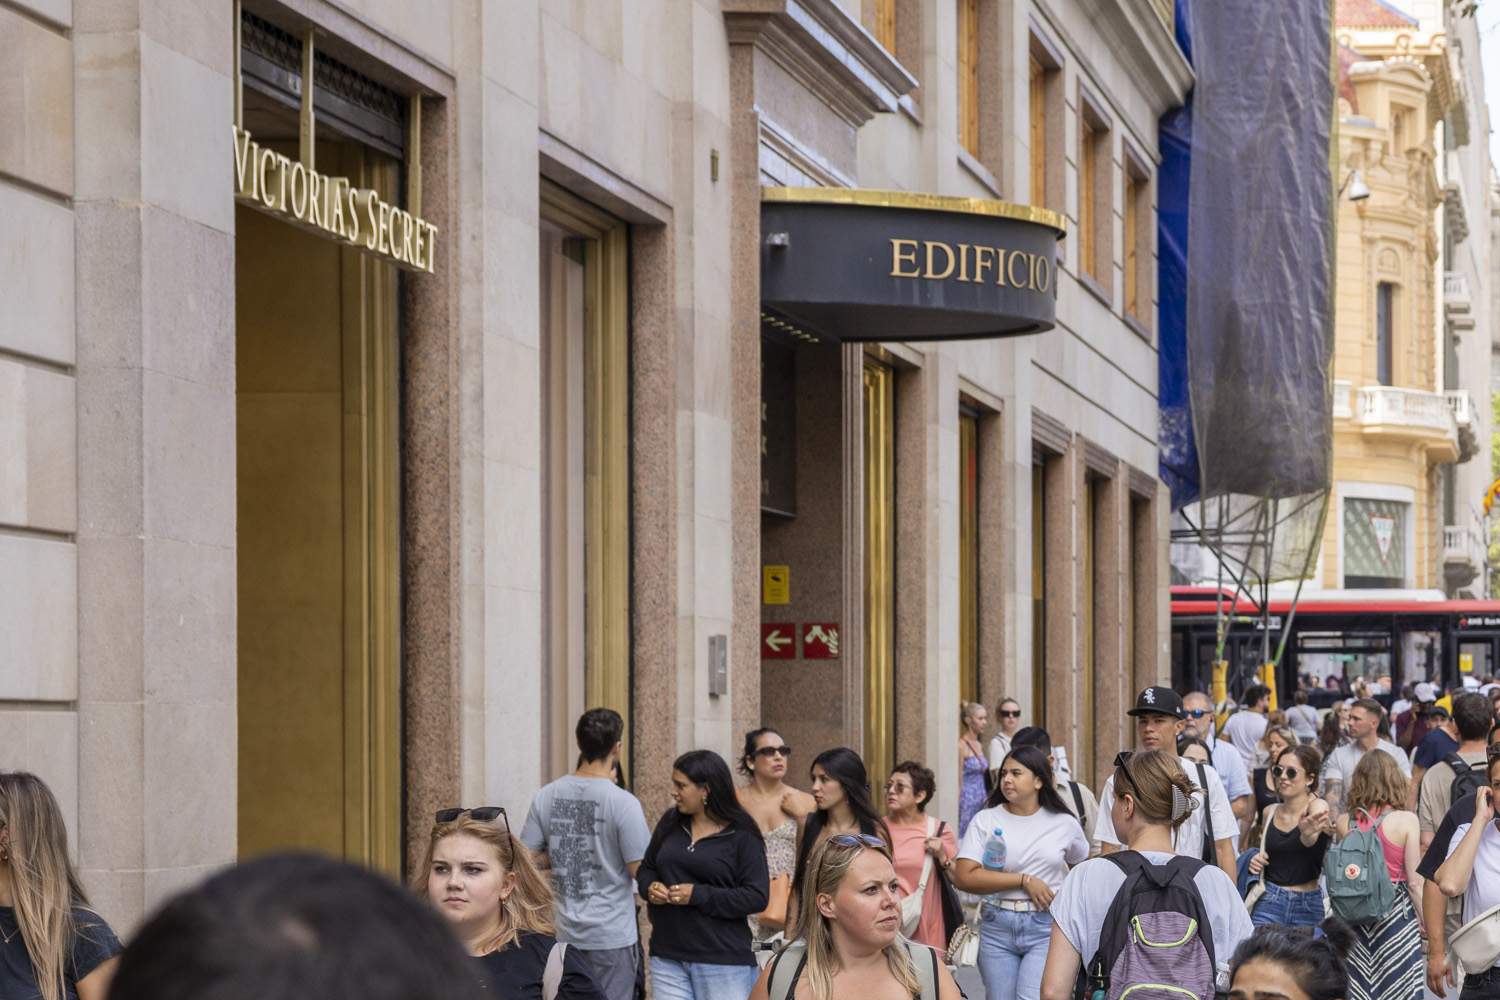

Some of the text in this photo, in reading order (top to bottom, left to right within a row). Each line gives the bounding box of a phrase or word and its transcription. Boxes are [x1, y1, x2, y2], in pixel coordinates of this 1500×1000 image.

[232, 125, 438, 274] VICTORIA'S SECRET
[889, 238, 1050, 293] EDIFICIO
